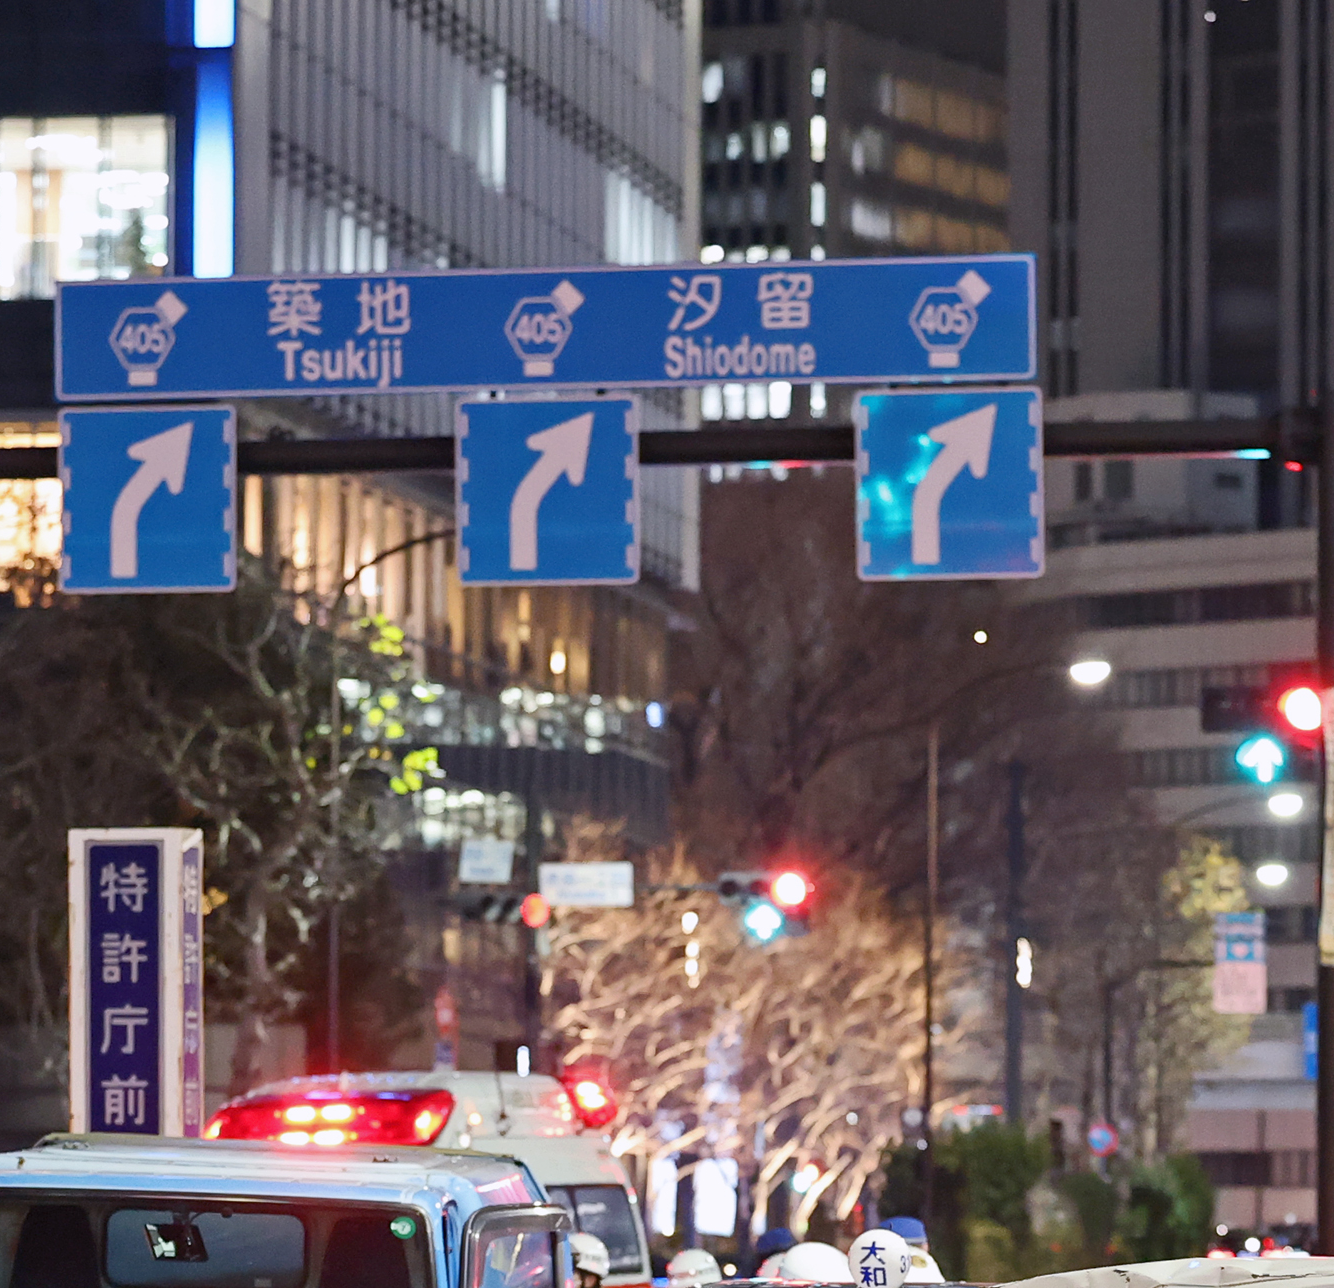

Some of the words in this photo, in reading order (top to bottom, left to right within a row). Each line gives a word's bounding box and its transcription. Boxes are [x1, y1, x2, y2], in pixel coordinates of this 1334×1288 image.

[267, 280, 410, 336] 築地
[667, 272, 814, 330] 汐留
[919, 303, 966, 335] 405
[118, 324, 166, 353] 405
[513, 314, 561, 343] 405
[277, 338, 402, 388] Tsukiji
[664, 336, 816, 378] Shiodome
[100, 861, 149, 1126] 特許庁前
[859, 1241, 887, 1287] 大和
